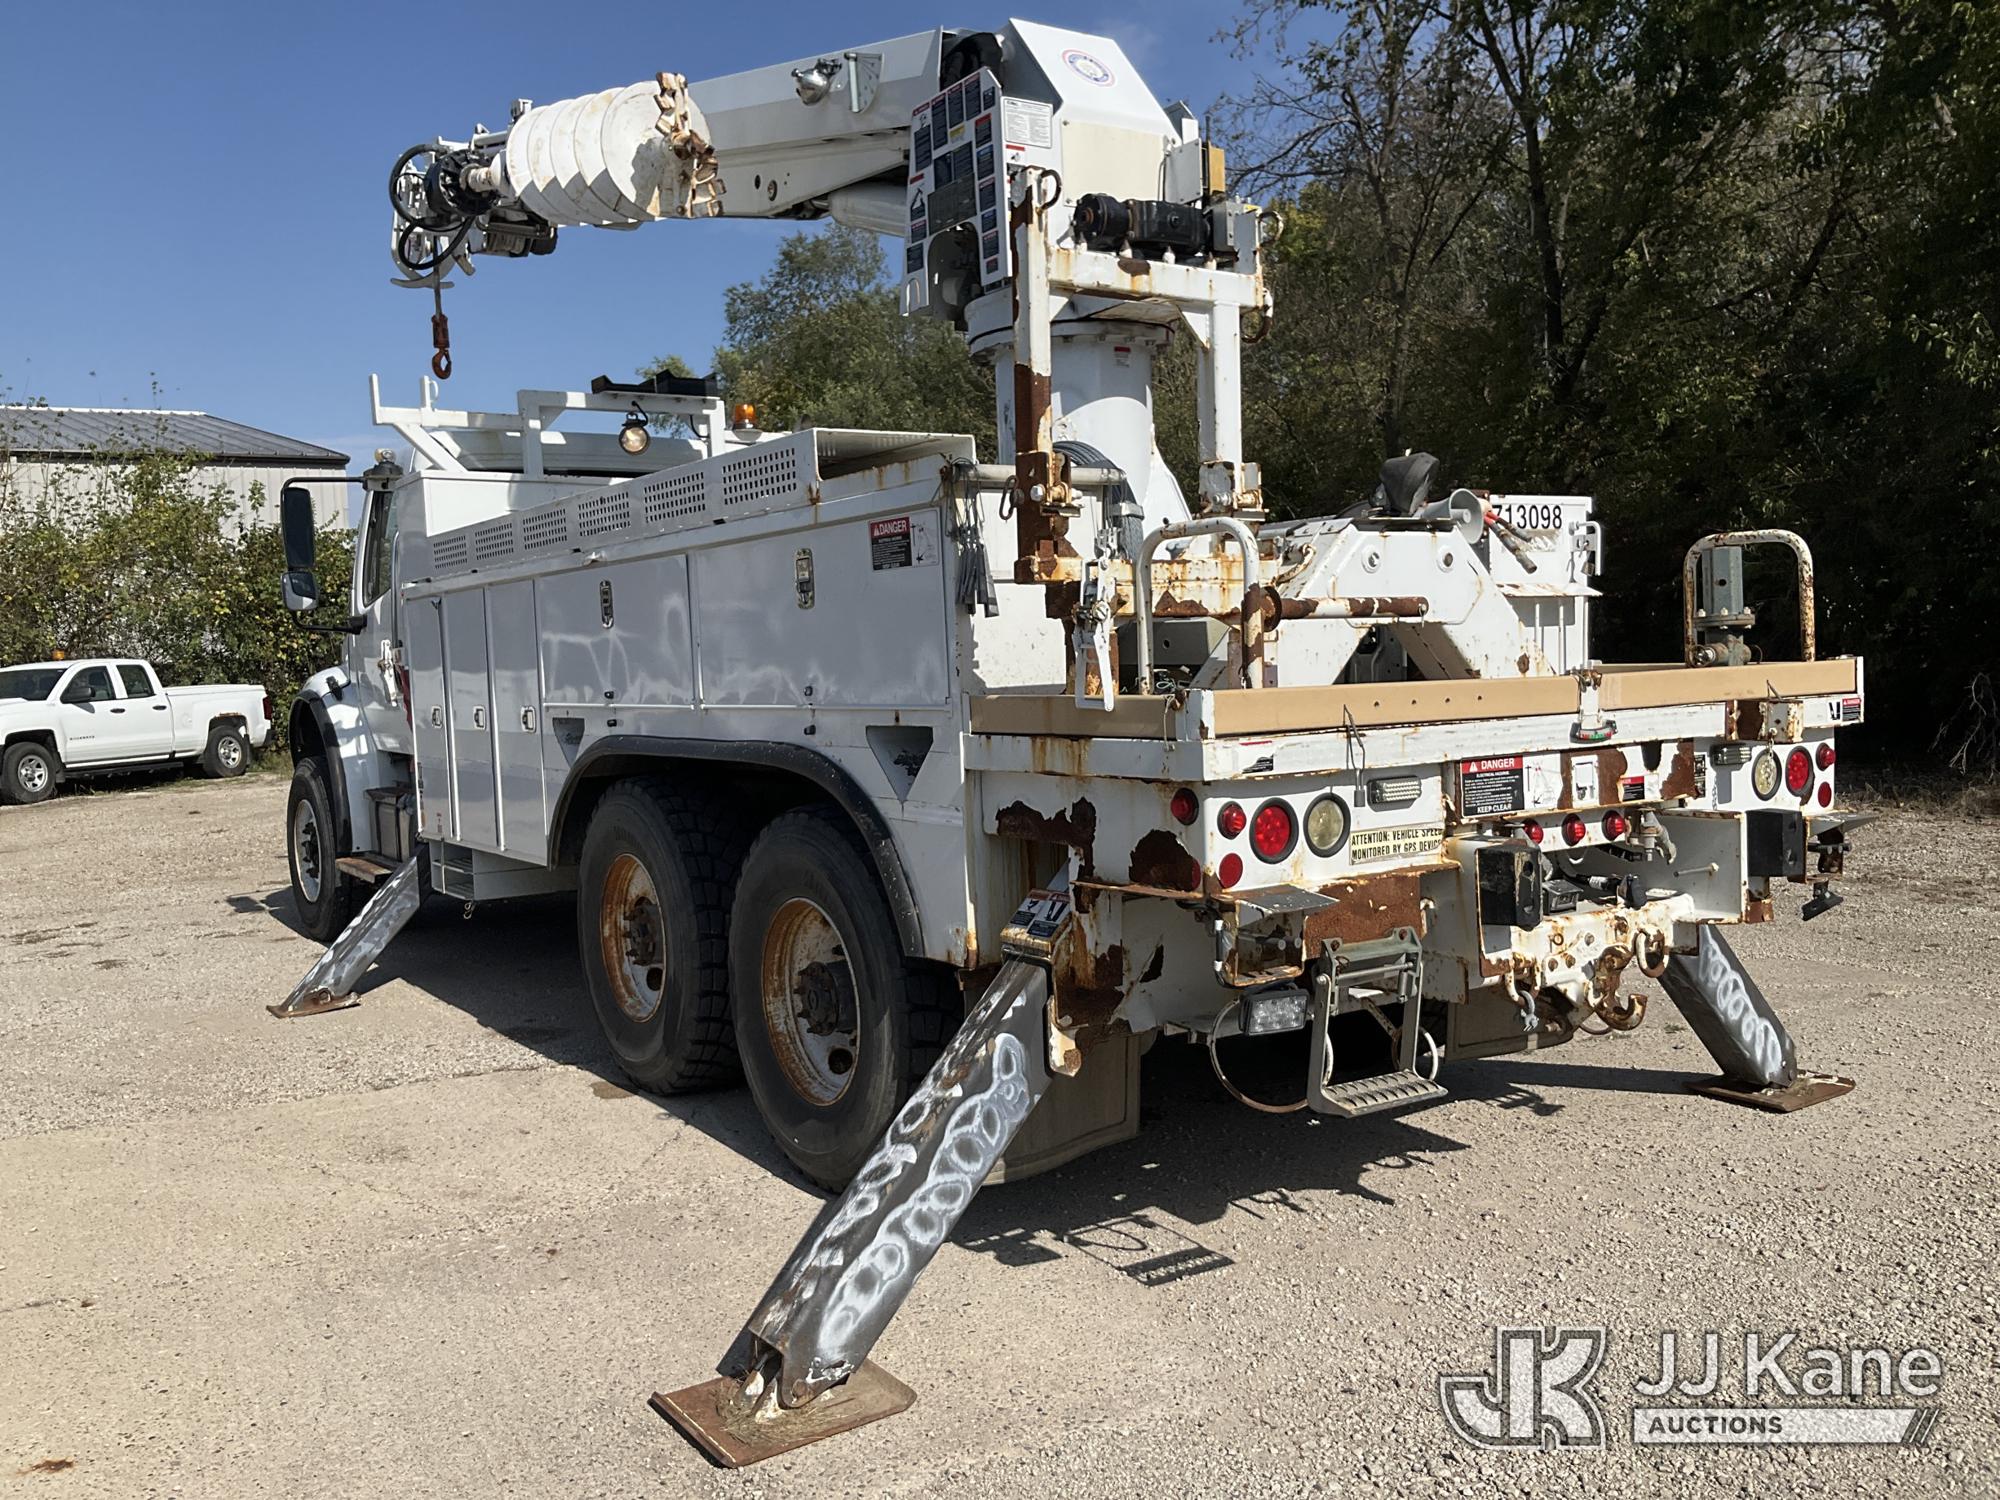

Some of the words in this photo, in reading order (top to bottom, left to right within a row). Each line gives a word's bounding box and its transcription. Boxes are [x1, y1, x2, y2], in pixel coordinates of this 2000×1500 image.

[1492, 504, 1562, 529] 713098
[880, 520, 907, 534] DANGER
[1481, 758, 1515, 770] DANGER
[1477, 805, 1492, 813] KEEP
[1493, 803, 1512, 812] CLEAR
[1351, 831, 1391, 846] ATTENTION:
[1392, 829, 1419, 841] VEHICLE
[1351, 845, 1390, 860] MONITORED
[1404, 842, 1416, 853] GPS
